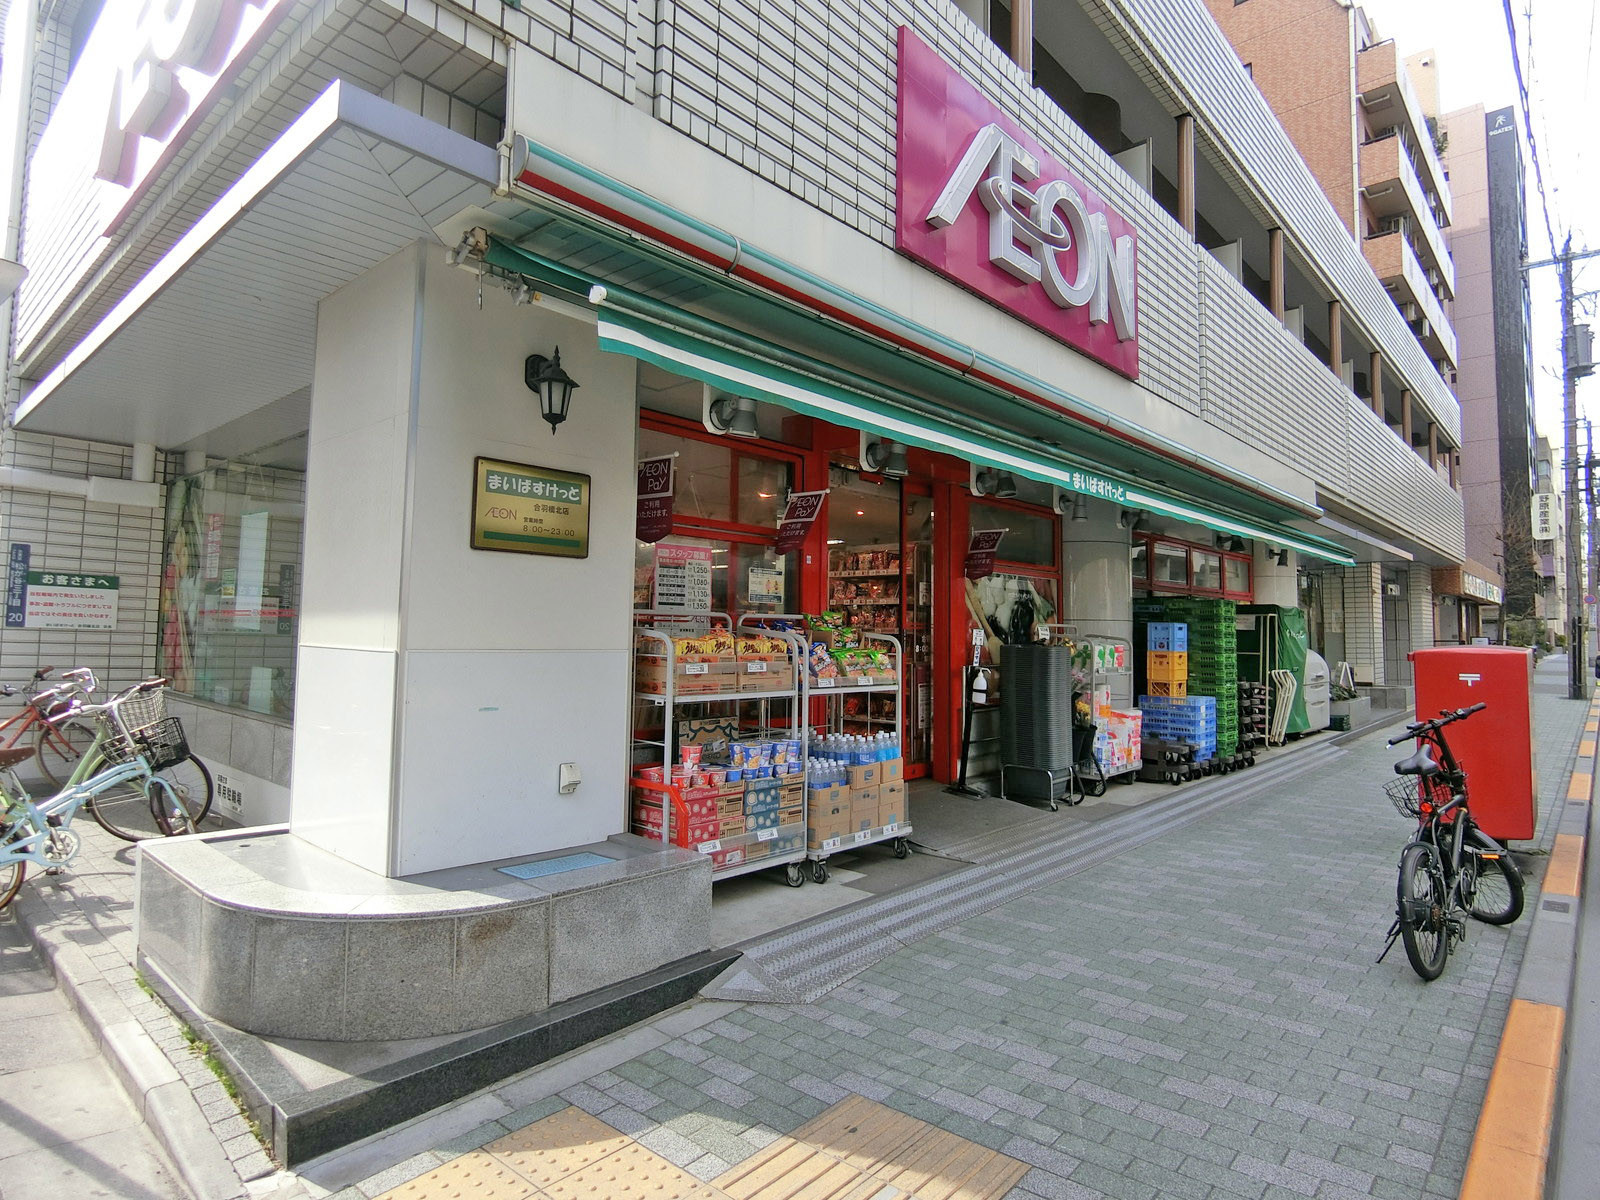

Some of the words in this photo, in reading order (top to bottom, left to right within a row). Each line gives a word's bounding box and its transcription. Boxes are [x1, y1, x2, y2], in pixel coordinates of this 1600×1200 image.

[487, 474, 580, 501] まいばすけっと
[1072, 472, 1124, 501] まいばすけっと
[533, 503, 570, 516] 合羽橋北店
[42, 574, 110, 587] お客さまへ
[8, 612, 23, 622] 20
